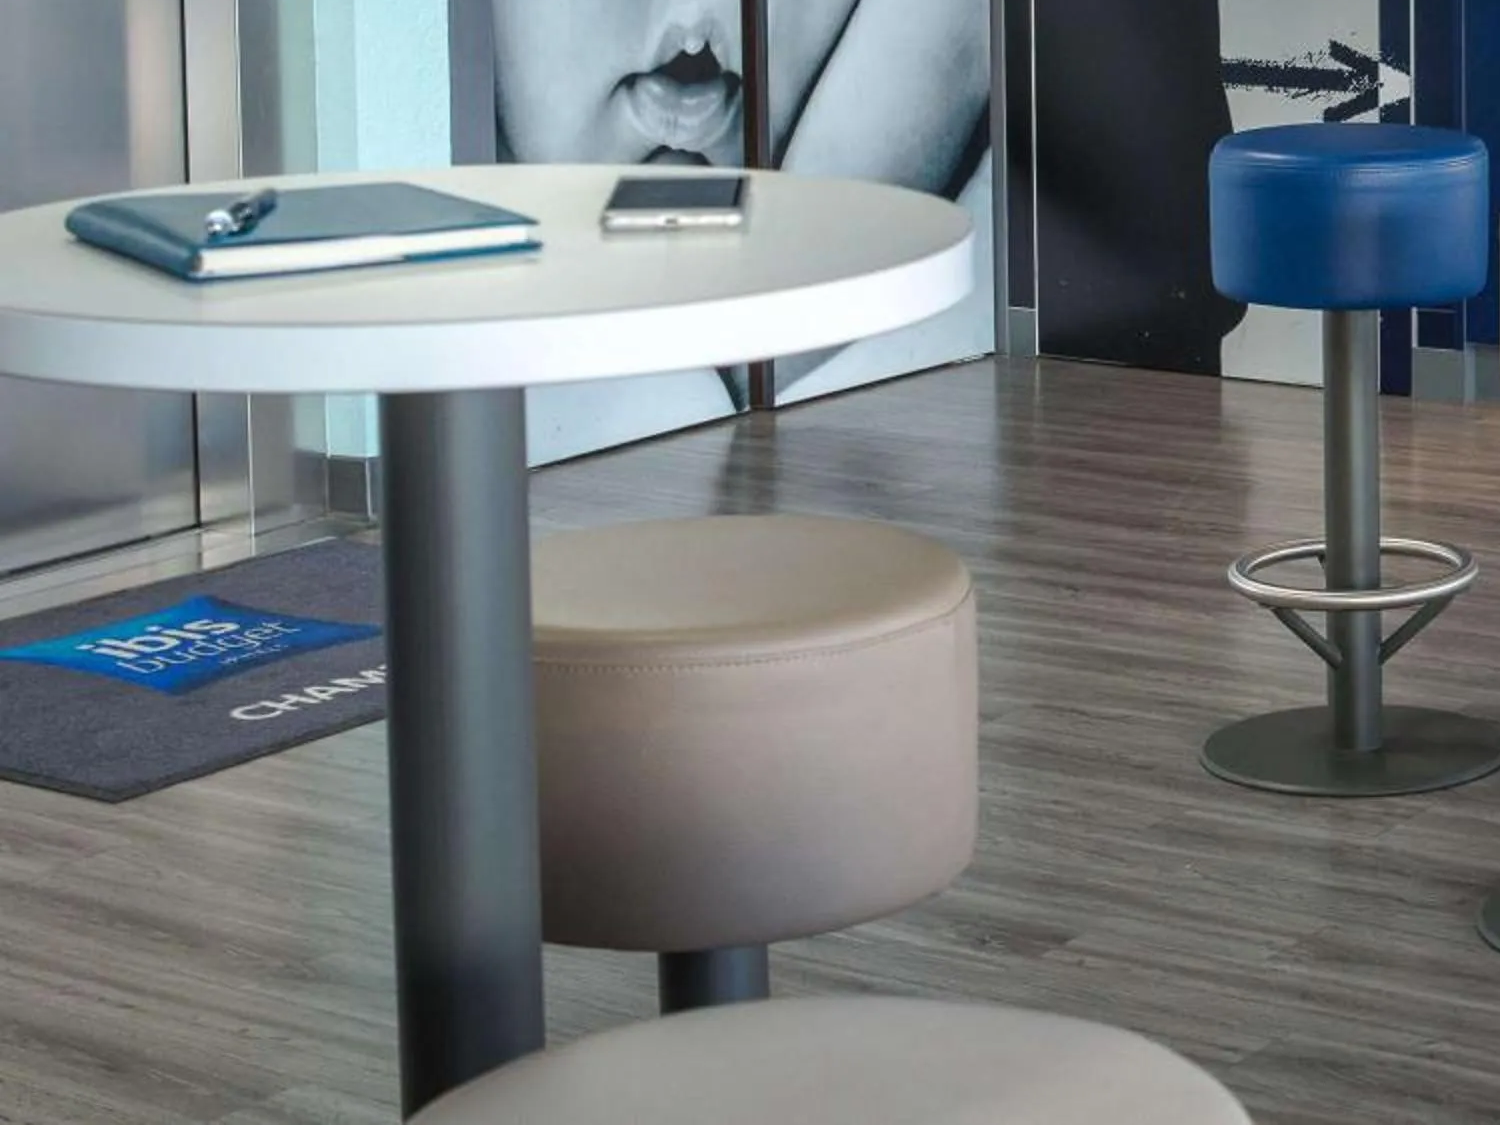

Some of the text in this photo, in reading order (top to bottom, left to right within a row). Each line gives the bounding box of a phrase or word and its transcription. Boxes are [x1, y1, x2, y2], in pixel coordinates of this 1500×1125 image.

[76, 619, 240, 660] ibis
[115, 620, 300, 674] budget
[229, 663, 387, 721] CHAM
